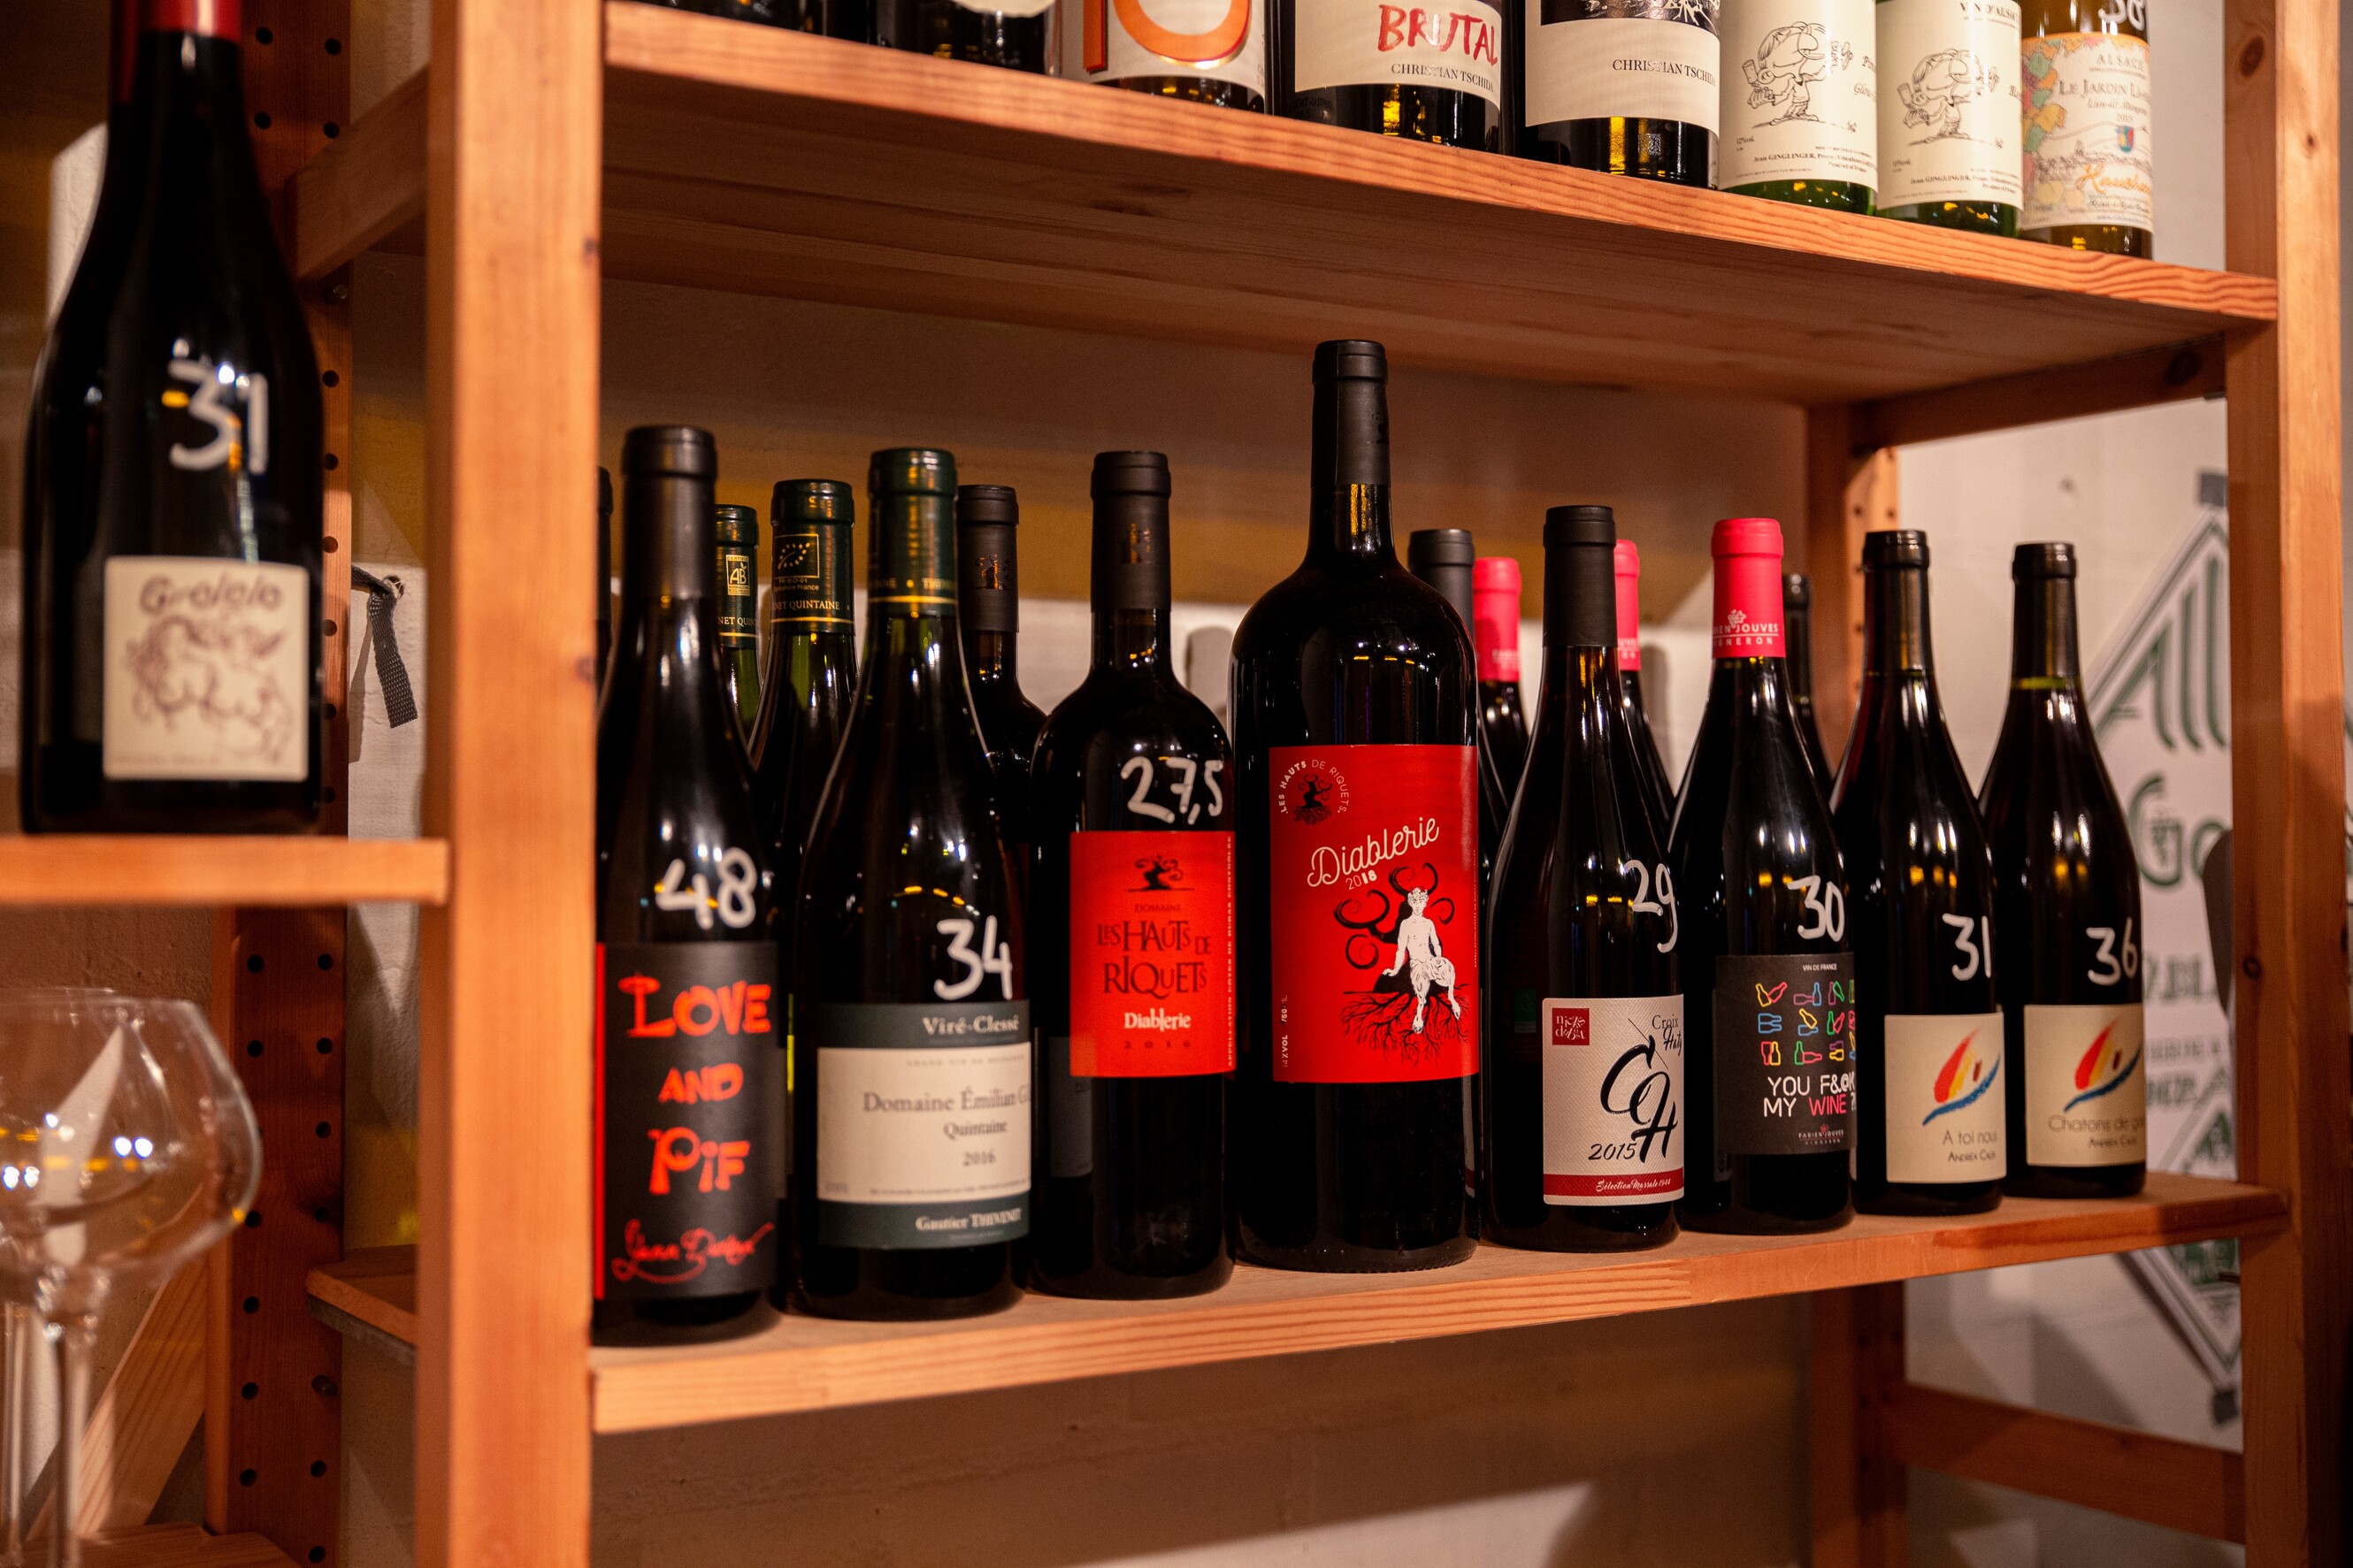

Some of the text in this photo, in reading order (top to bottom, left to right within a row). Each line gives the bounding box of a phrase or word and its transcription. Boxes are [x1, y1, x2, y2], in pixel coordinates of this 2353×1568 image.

[1378, 4, 1498, 65] BRUTAL
[1391, 64, 1494, 93] CHRISTIAN TSCHIDA
[1613, 59, 1682, 74] CHRISTIAN
[2059, 80, 2078, 96] LE
[2080, 80, 2128, 97] JARDIN
[168, 358, 270, 475] 31
[730, 568, 747, 585] AB
[789, 600, 839, 611] QUINTAINE
[1736, 623, 1779, 633] JOUVES
[1279, 761, 1307, 789] HAUTS
[1311, 759, 1326, 769] DE
[1120, 756, 1223, 825] 27,5
[1307, 816, 1439, 887] Diablerie
[655, 846, 757, 929] 48
[1345, 869, 1377, 891] 2018
[1625, 860, 1679, 952] 29
[1787, 875, 1845, 942] 30
[1098, 921, 1211, 955] LES HAUTS DE
[1942, 913, 1992, 981] 31
[2086, 916, 2139, 985] 36
[933, 915, 1013, 1000] 34
[1103, 955, 1207, 1000] RIQUETS
[619, 974, 772, 1037] LOVE
[1124, 1007, 1192, 1032] Diablerie
[1652, 1013, 1679, 1029] Croix
[658, 1063, 743, 1104] AND
[1767, 1071, 1855, 1097] YOU F&@K
[863, 1090, 955, 1113] Domaine
[1763, 1097, 1797, 1117] MY
[1808, 1093, 1846, 1116] WINE
[1588, 1143, 1636, 1160] 2015
[1942, 1130, 1953, 1146] A
[648, 1127, 751, 1195] PIF
